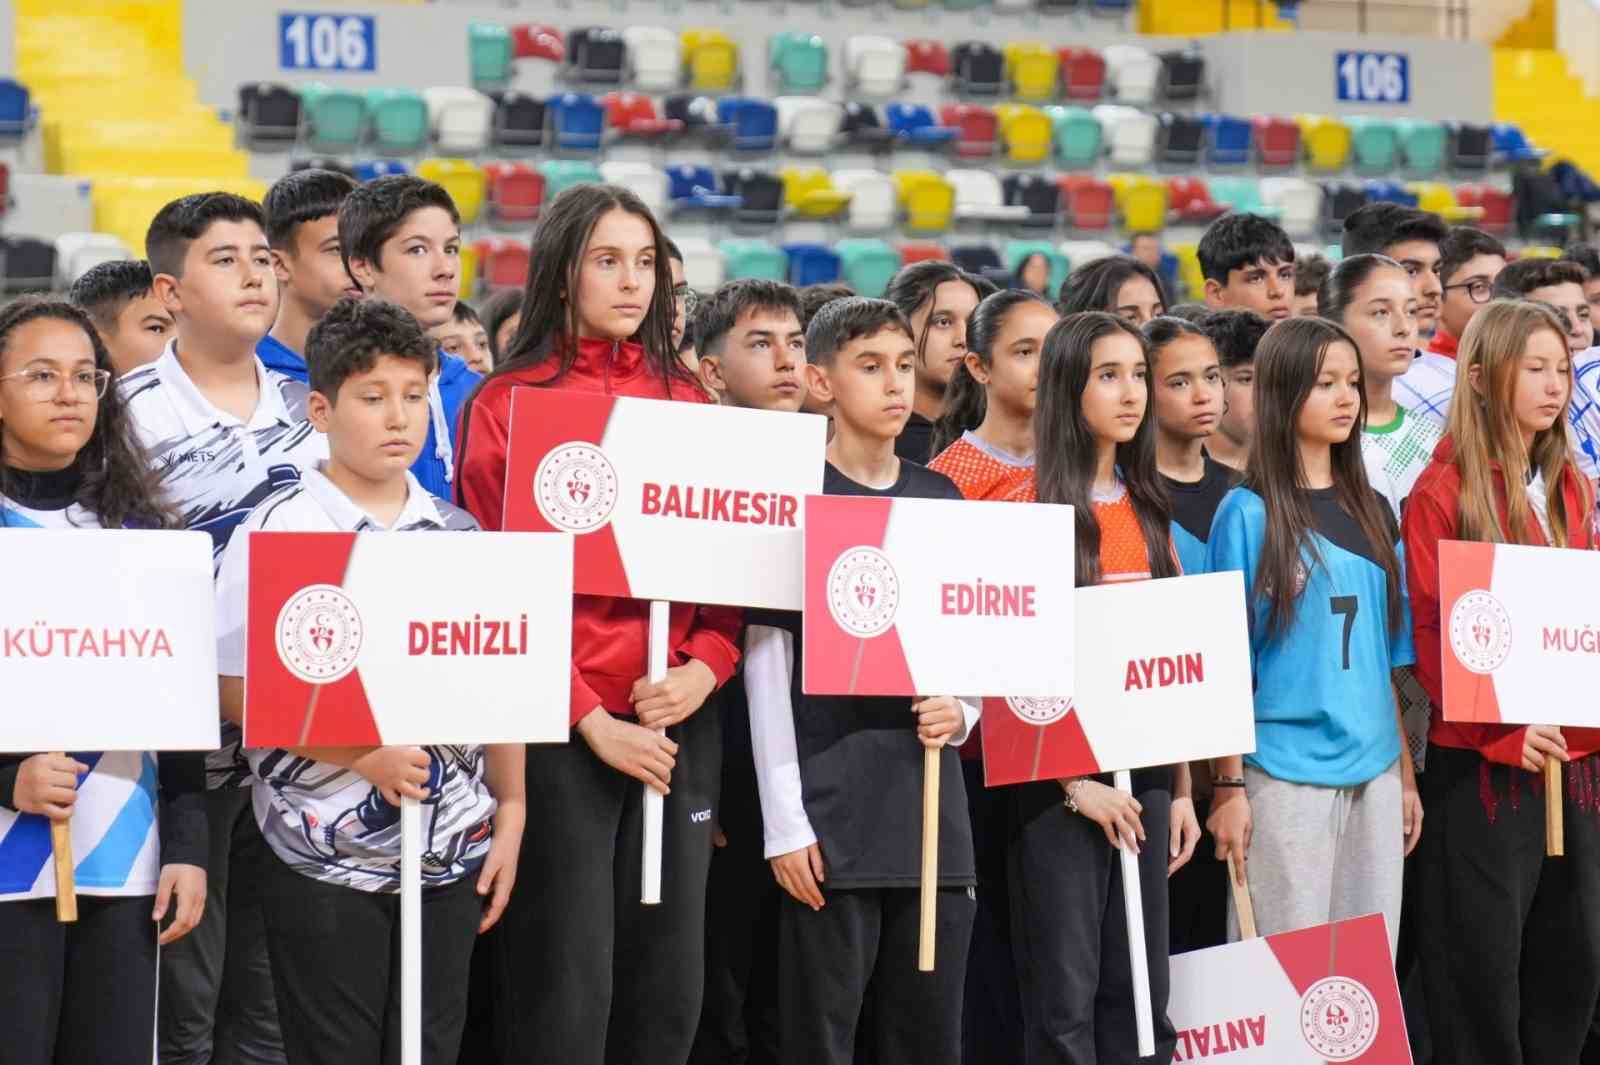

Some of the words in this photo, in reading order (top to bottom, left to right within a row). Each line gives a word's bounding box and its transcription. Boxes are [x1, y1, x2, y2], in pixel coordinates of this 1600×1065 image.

[286, 15, 367, 67] 106
[1341, 55, 1403, 100] 106
[941, 577, 1036, 617] EDİRNE
[4, 620, 173, 657] KÜTAHYA
[408, 613, 528, 656] DENİZLİ
[1330, 595, 1358, 670] 7
[1124, 652, 1204, 692] AYDIN
